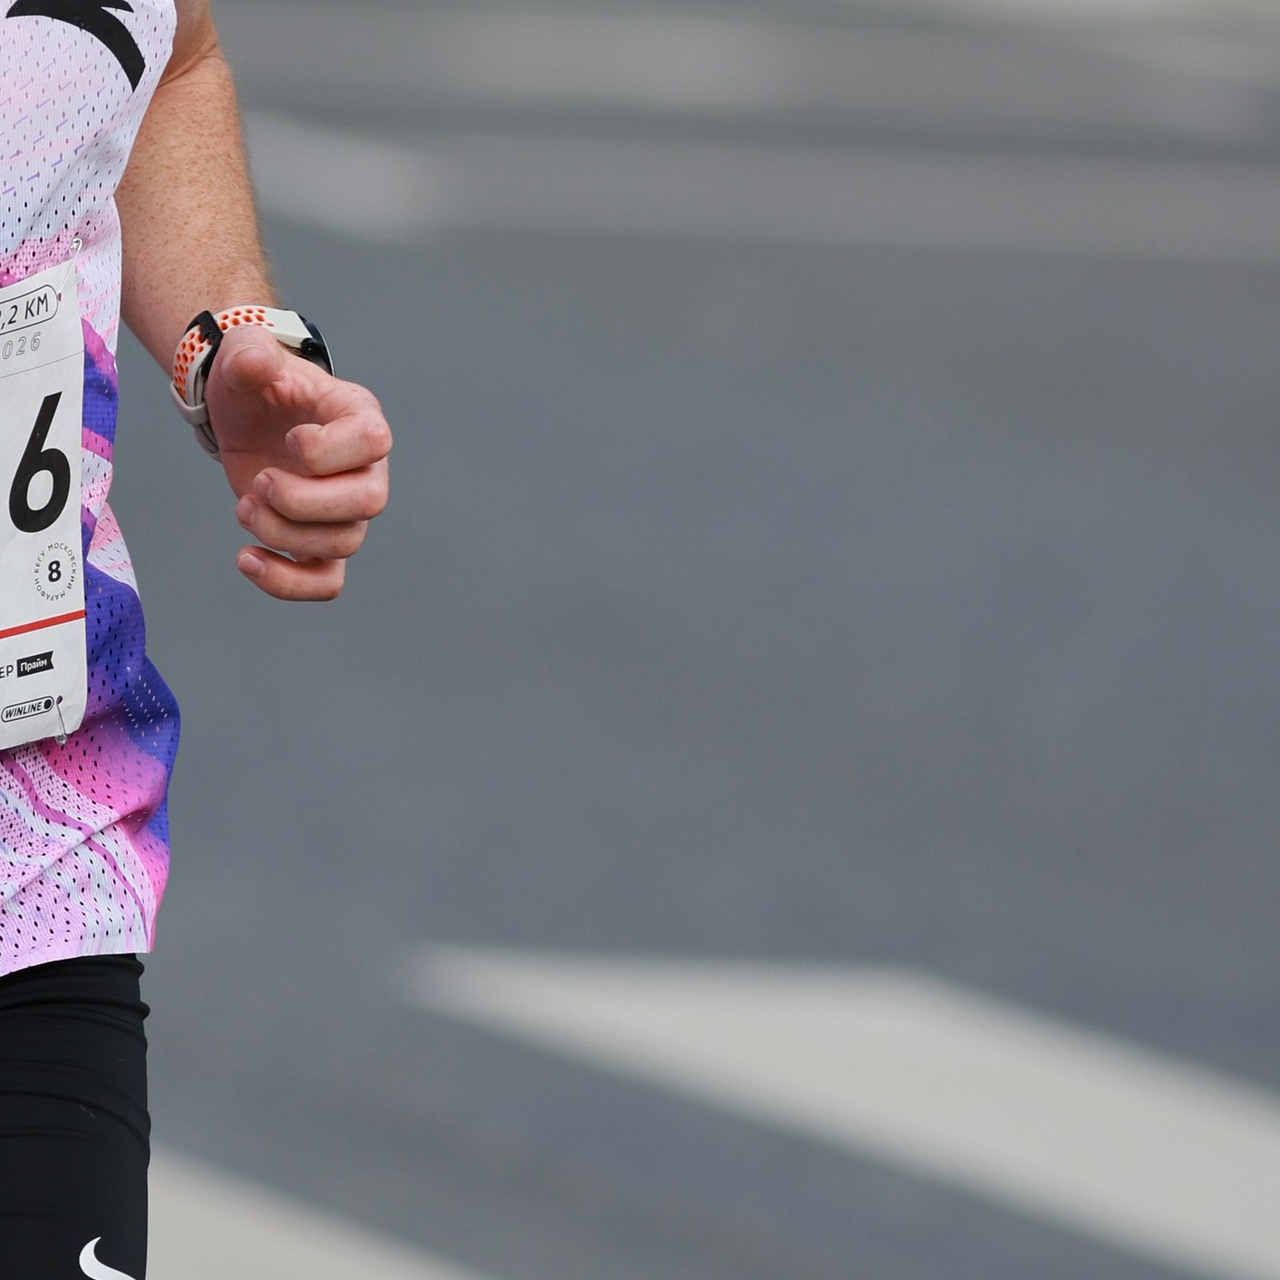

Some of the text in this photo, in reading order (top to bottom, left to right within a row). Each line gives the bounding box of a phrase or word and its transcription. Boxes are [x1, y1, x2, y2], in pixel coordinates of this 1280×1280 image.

[48, 560, 62, 583] 8
[20, 657, 48, 673] Прайм
[5, 701, 43, 719] WINLINE
